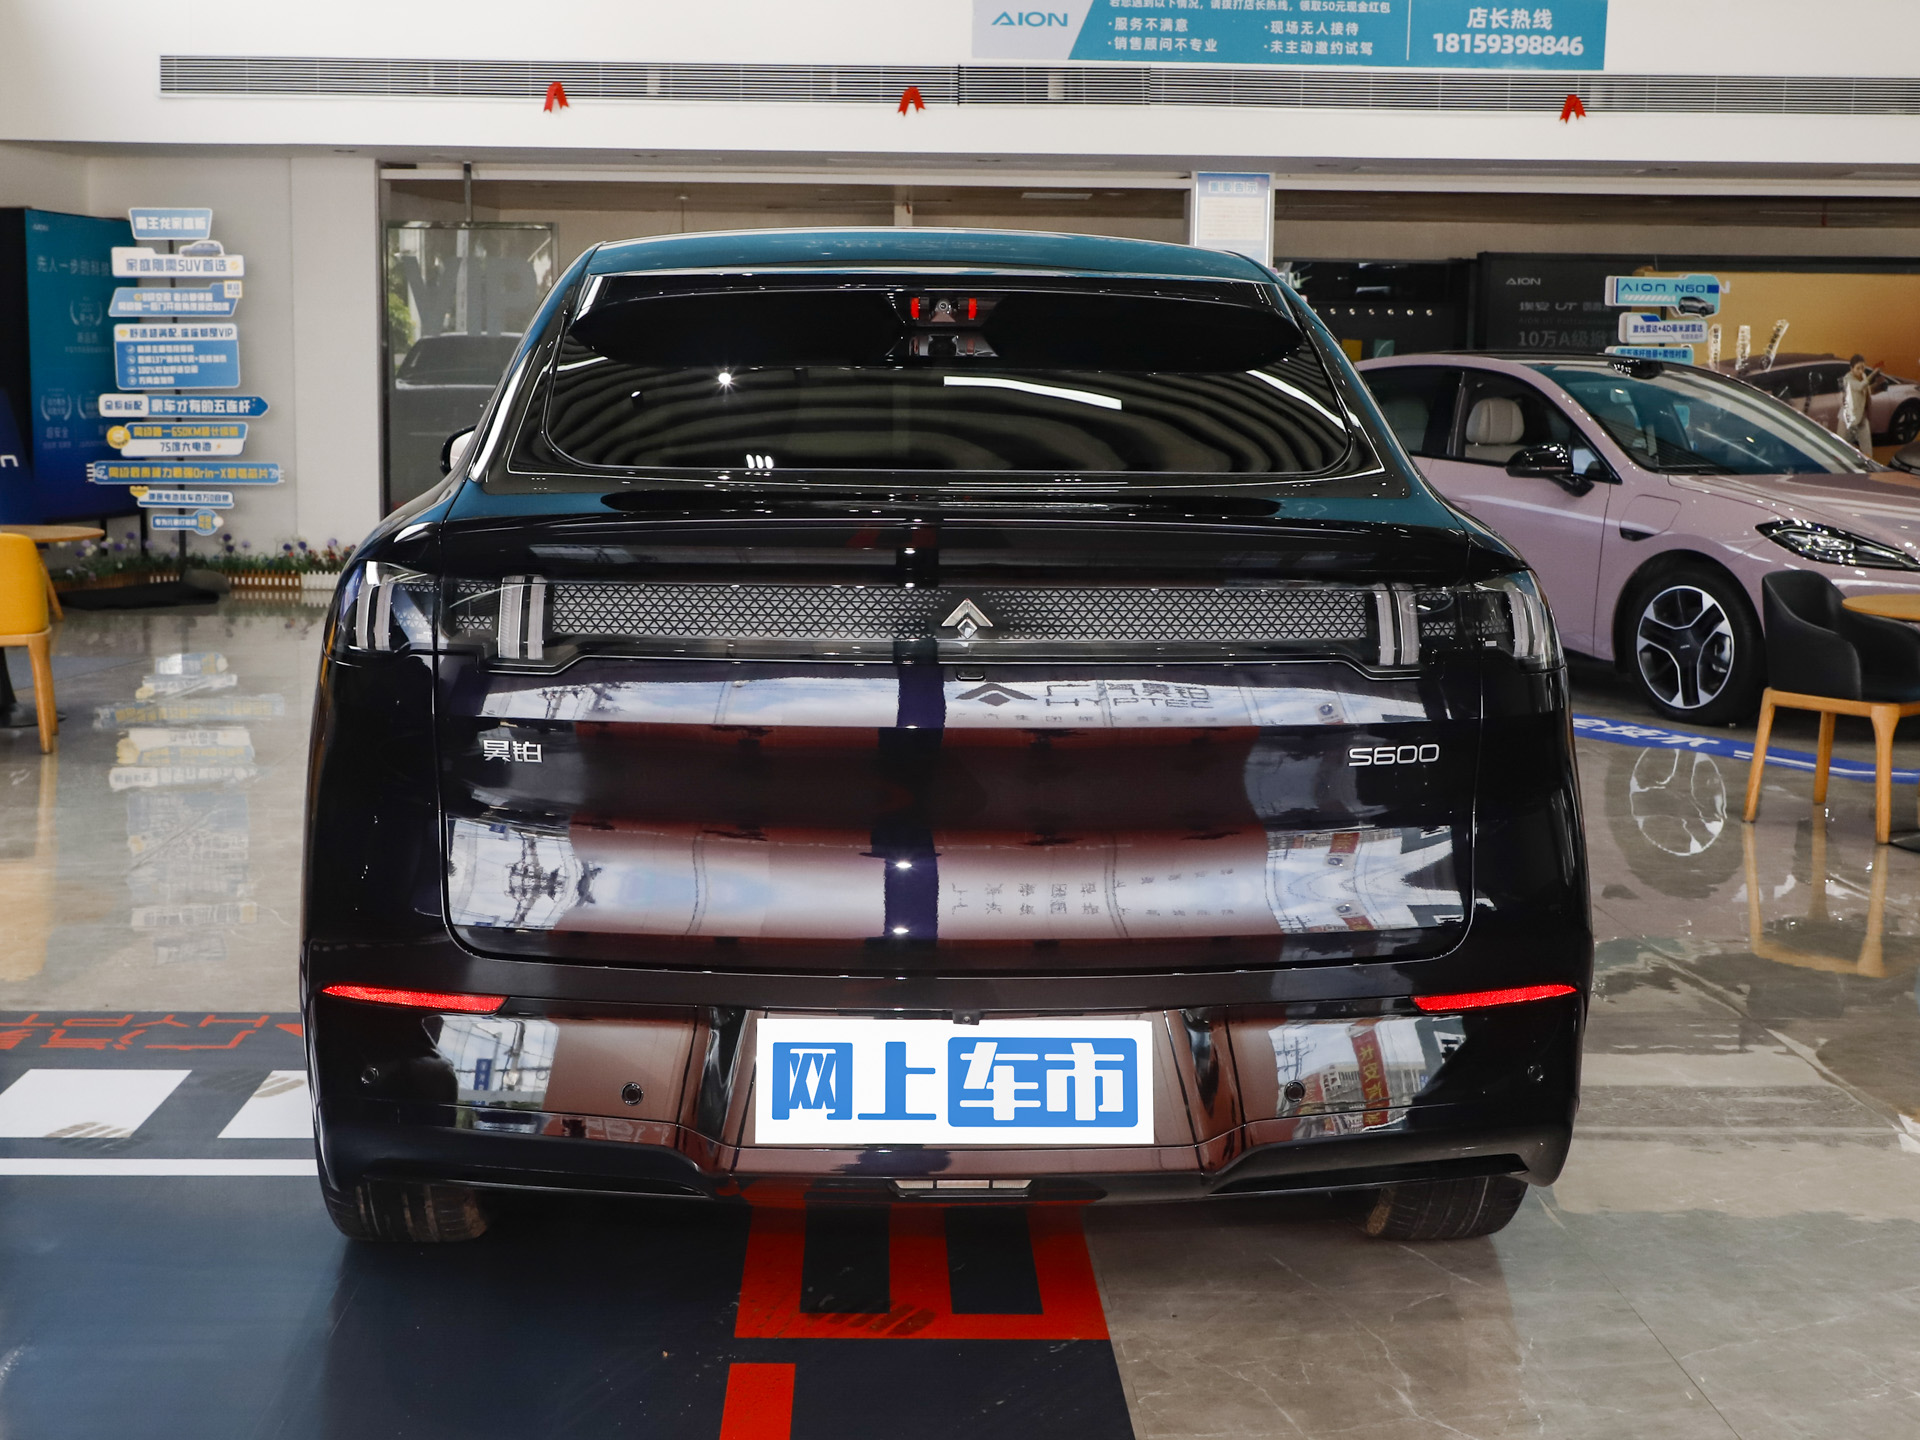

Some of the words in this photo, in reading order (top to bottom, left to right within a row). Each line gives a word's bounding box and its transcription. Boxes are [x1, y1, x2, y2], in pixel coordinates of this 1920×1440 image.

[991, 11, 1068, 27] AION
[1114, 17, 1188, 31] 服务不满意
[1467, 7, 1553, 30] 店长热线
[1270, 20, 1359, 36] 现场无人接待
[1114, 36, 1218, 52] 销售顾问不专业
[1270, 40, 1374, 56] 未主动邀约试驾
[1433, 33, 1584, 56] 18159398846
[1506, 277, 1541, 286] AION
[1674, 284, 1705, 293] N60
[483, 740, 543, 763] 昊铂
[1348, 743, 1440, 767] S600
